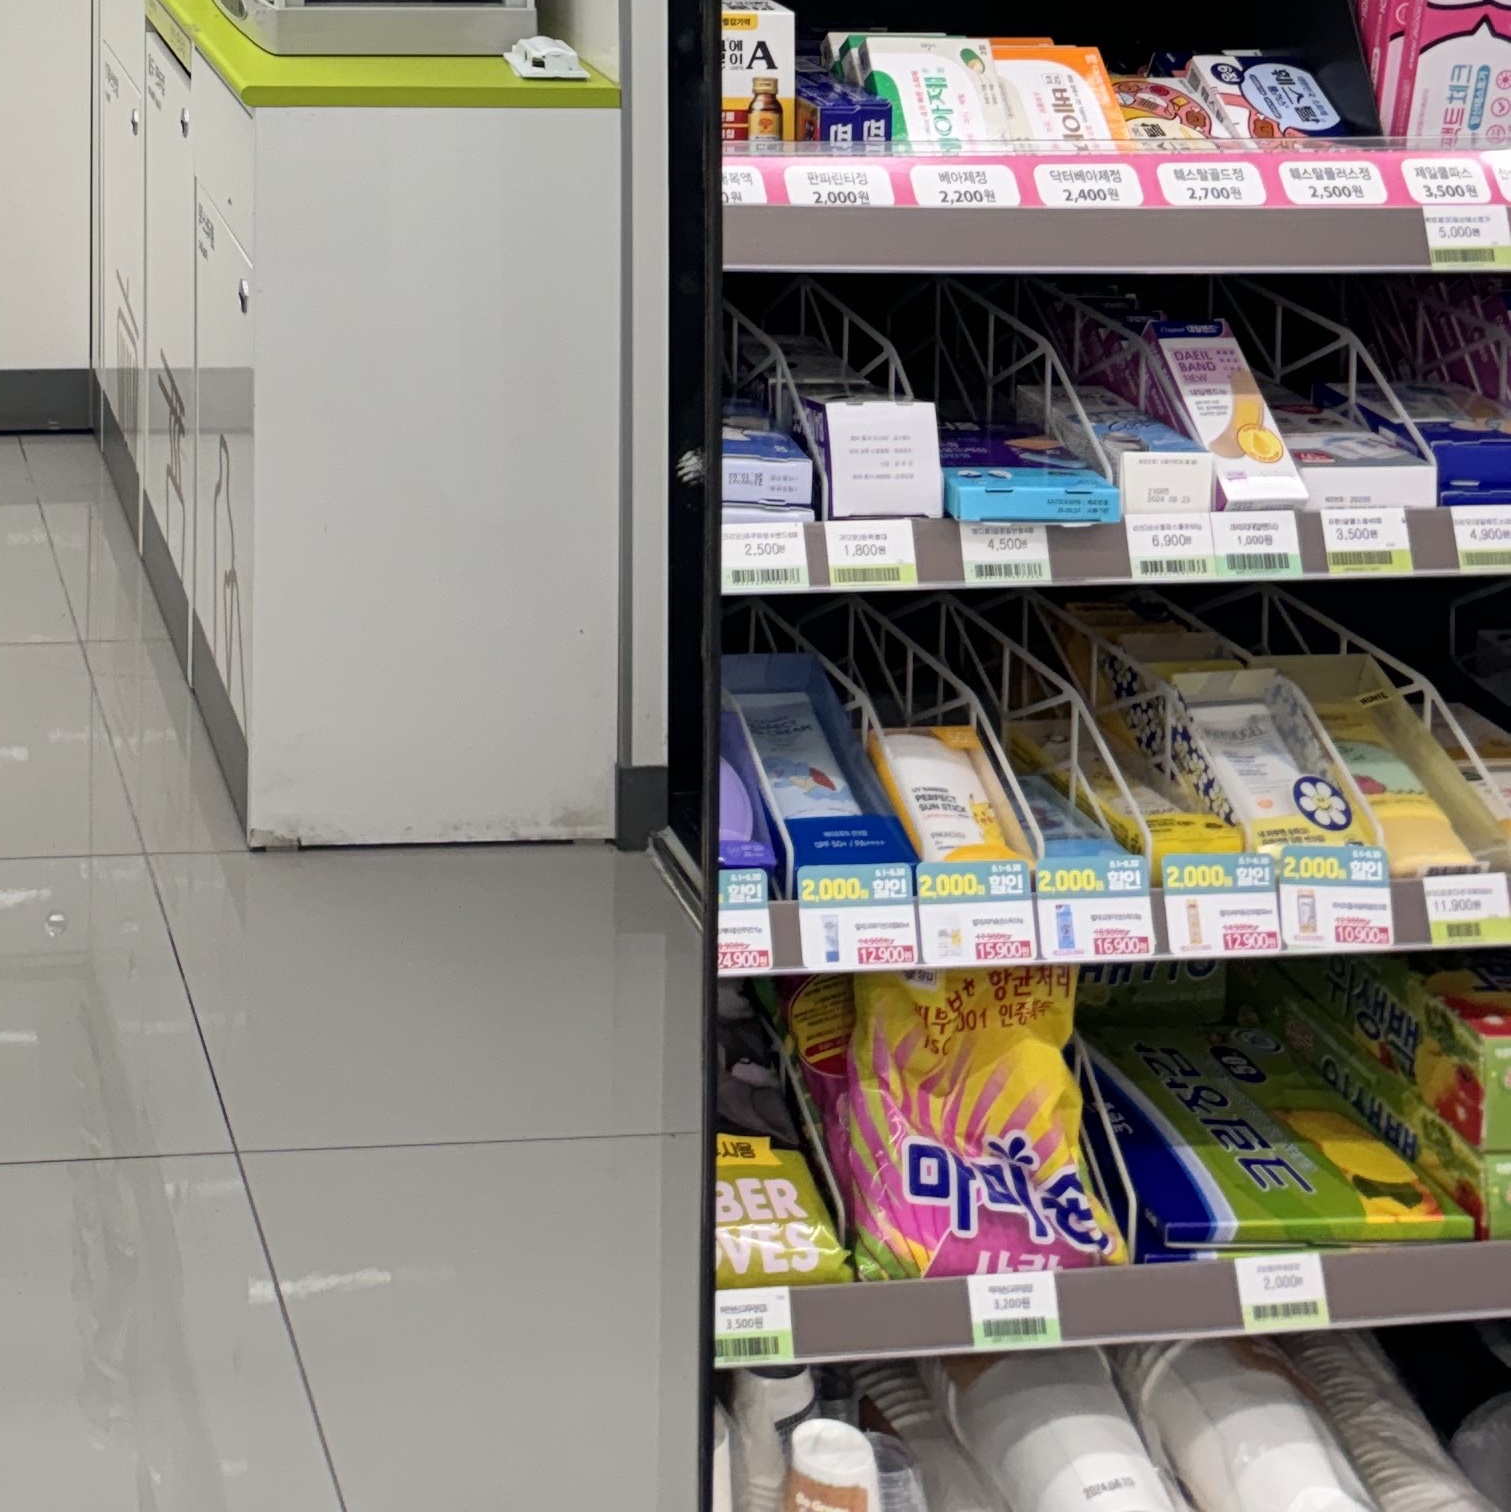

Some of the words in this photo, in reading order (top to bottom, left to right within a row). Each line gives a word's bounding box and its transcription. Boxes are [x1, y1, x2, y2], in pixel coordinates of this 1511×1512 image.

[746, 40, 778, 70] A
[1448, 64, 1472, 104] 체크
[807, 172, 869, 186] 판피린티정
[938, 170, 988, 185] 베아제정
[1049, 168, 1121, 184] 닥터베아제정
[1173, 167, 1245, 183] 훼스탈골드정
[1289, 167, 1372, 181] 훼스탈플러스정
[1414, 166, 1473, 180] 제일쿨파스
[812, 191, 870, 205] 2,000원
[938, 190, 997, 204] 2,200원
[1062, 187, 1120, 202] 2,400원
[1186, 186, 1243, 200] 2,700원
[1308, 184, 1365, 199] 2,500원
[1423, 184, 1479, 199] 3,500원
[1439, 226, 1481, 239] 5,000원
[1173, 350, 1214, 361] DAEIL
[1178, 361, 1216, 372] BAND
[1151, 534, 1192, 547] 6,900원
[1237, 535, 1273, 546] 1,000원
[1336, 528, 1378, 541] 3,500원
[1470, 527, 1511, 541] 4,900원
[744, 543, 785, 556] 2,500원
[843, 543, 886, 557] 1,800원
[987, 537, 1028, 550] 4,500원
[1283, 855, 1347, 879] 2,000원
[1351, 860, 1383, 880] 할인
[1037, 869, 1104, 893] 2,000원
[1107, 870, 1141, 889] 할인
[1166, 865, 1232, 888] 2,000원
[1236, 867, 1270, 887] 할인
[801, 878, 869, 901] 2,000원
[872, 879, 907, 899] 할인
[918, 873, 985, 897] 2,000원
[989, 875, 1023, 894] 할인
[727, 884, 762, 904] 할인
[1433, 898, 1482, 912] 11,900원
[988, 968, 1072, 1001] 항균처리
[1133, 1041, 1317, 1195] 크린장갑
[906, 1136, 1110, 1251] 마미손
[1263, 1276, 1303, 1289] 2,000원
[993, 1297, 1031, 1309] 3,200원
[725, 1317, 764, 1330] 3,500원
